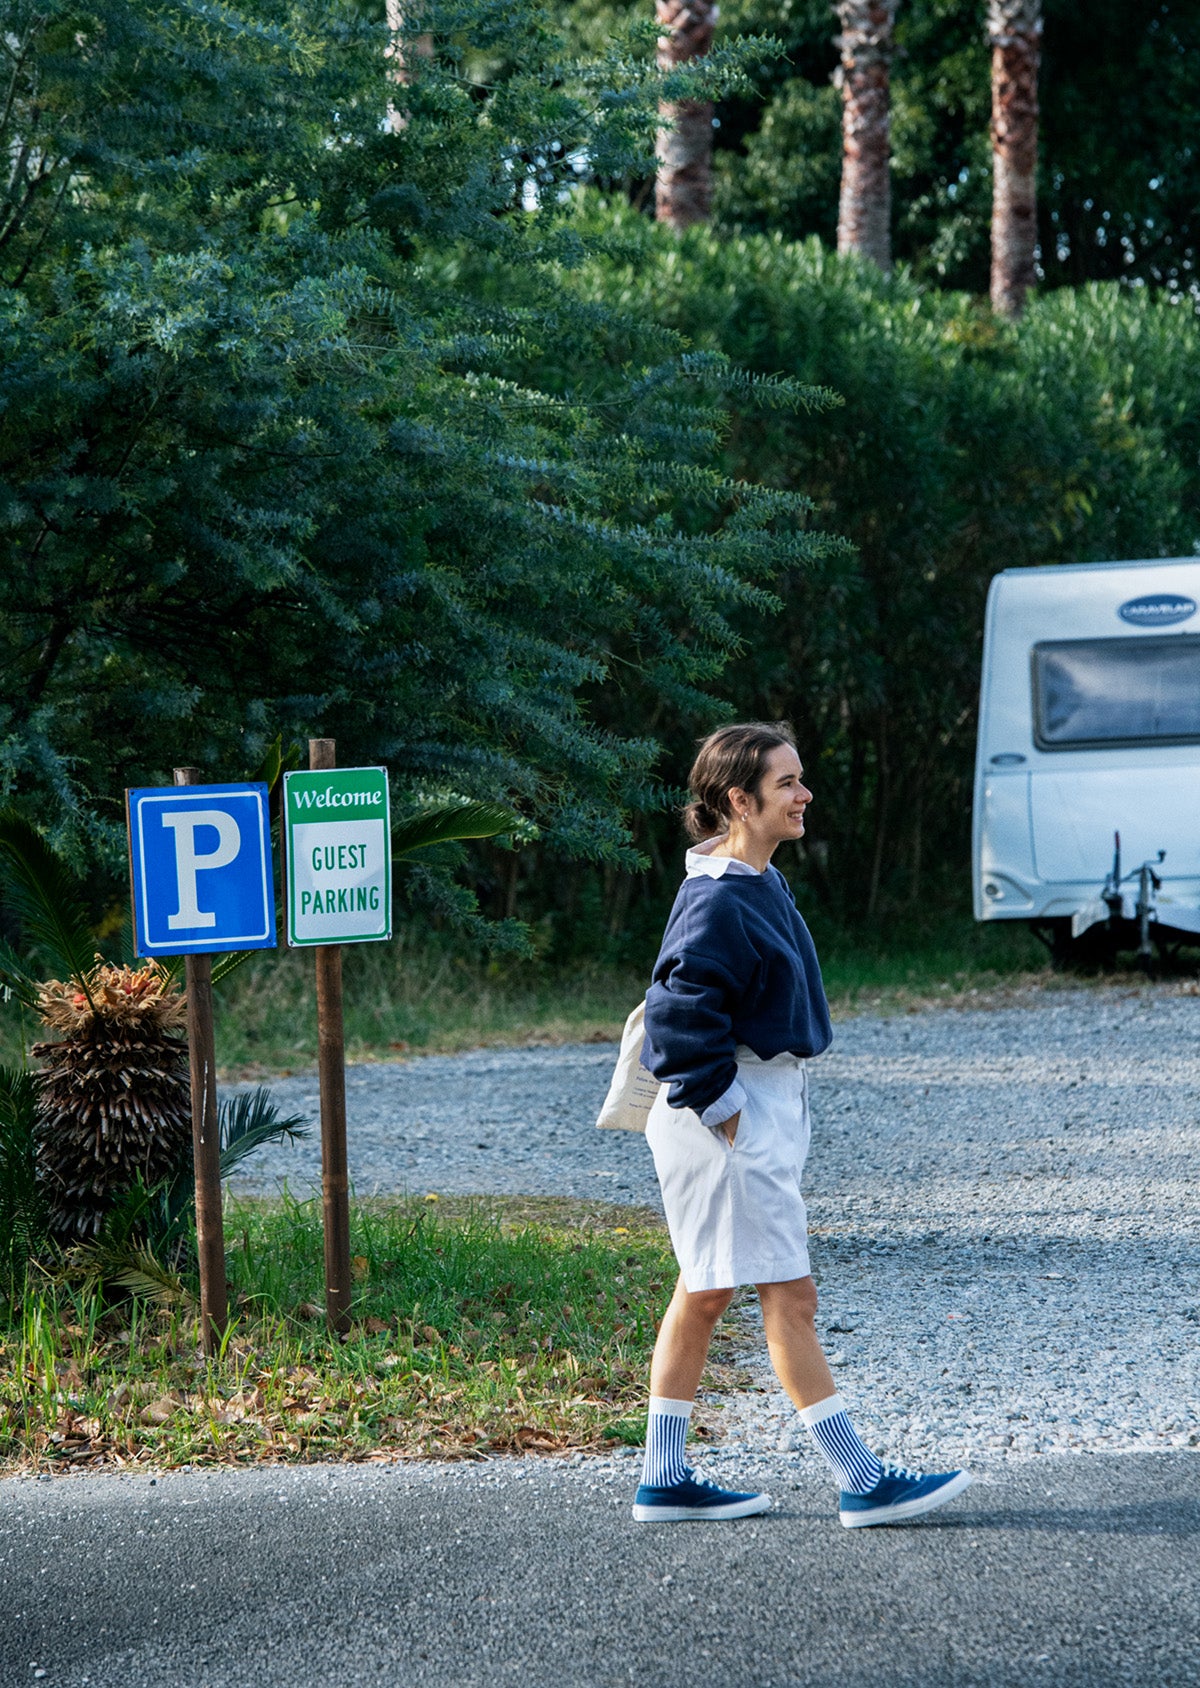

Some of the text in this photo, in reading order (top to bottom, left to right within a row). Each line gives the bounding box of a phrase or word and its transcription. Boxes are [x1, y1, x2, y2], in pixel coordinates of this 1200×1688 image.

[292, 786, 384, 809] Welcome
[161, 810, 241, 930] P
[312, 844, 367, 871] GUEST
[301, 886, 379, 915] PARKING
